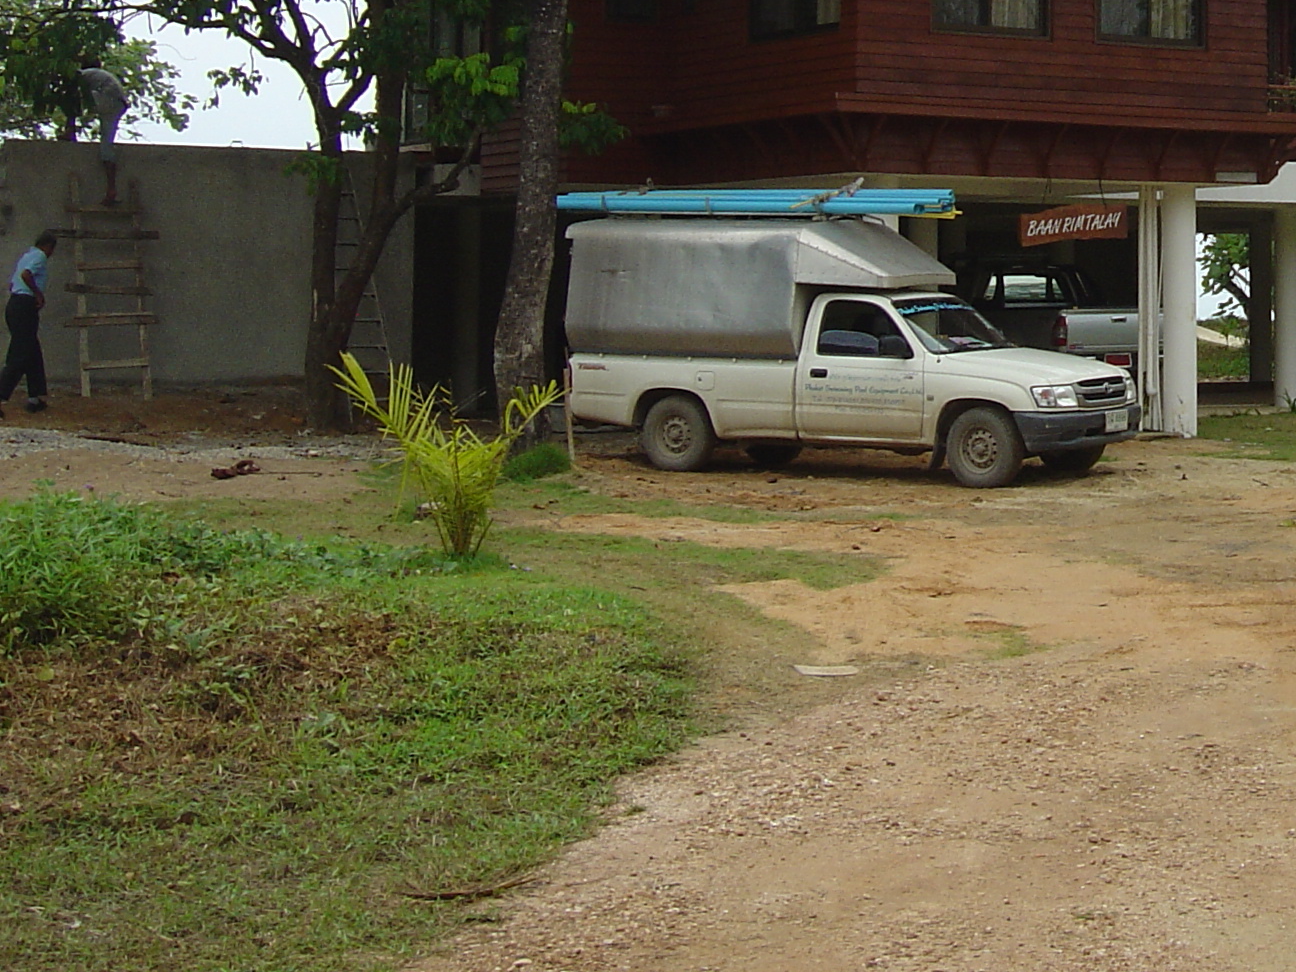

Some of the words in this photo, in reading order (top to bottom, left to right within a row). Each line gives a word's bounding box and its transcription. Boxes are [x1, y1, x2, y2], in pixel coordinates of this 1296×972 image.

[1027, 218, 1062, 236] BAAN
[1062, 214, 1085, 233] RIM
[1085, 211, 1122, 230] TALAY
